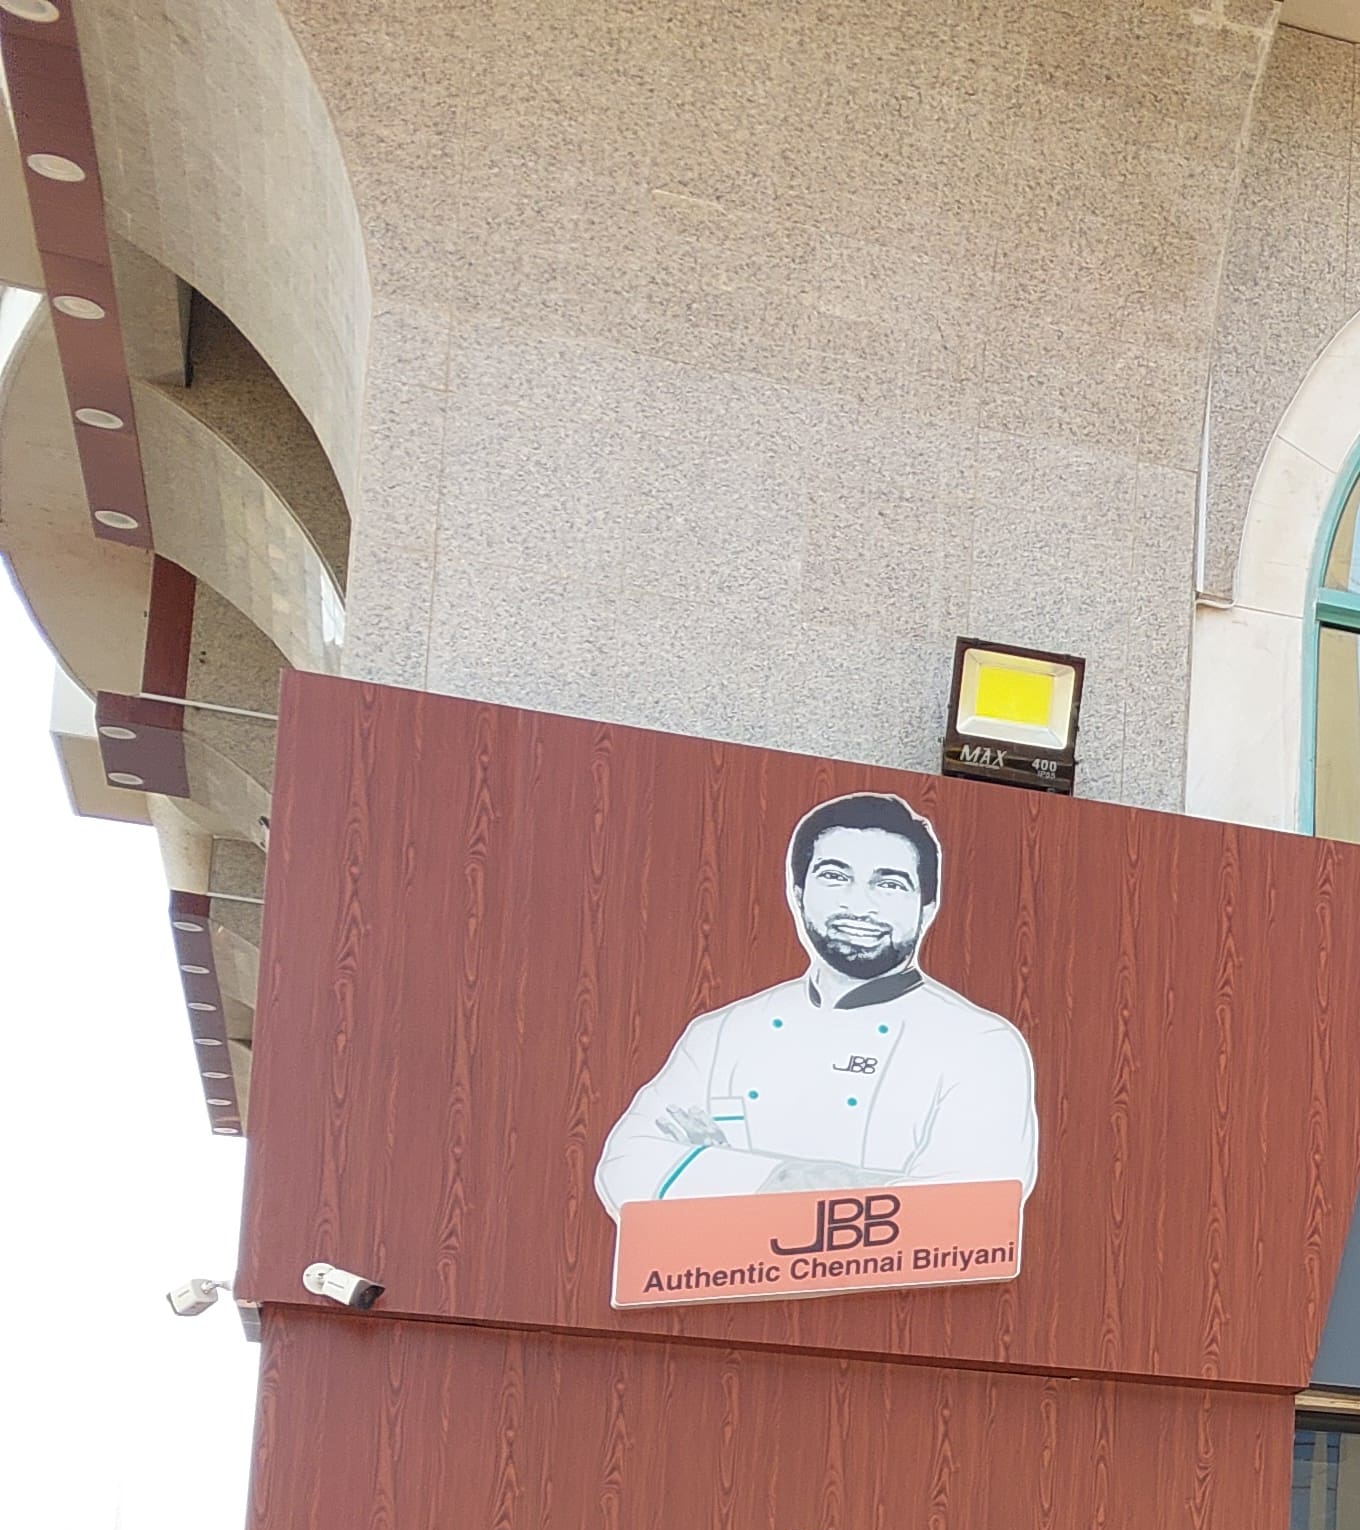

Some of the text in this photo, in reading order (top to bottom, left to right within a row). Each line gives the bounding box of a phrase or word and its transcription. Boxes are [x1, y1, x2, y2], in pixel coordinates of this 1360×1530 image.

[959, 744, 1057, 772] MAX 400
[770, 1193, 902, 1257] JBB
[643, 1240, 1015, 1294] Authentic Chennai Biriyani
